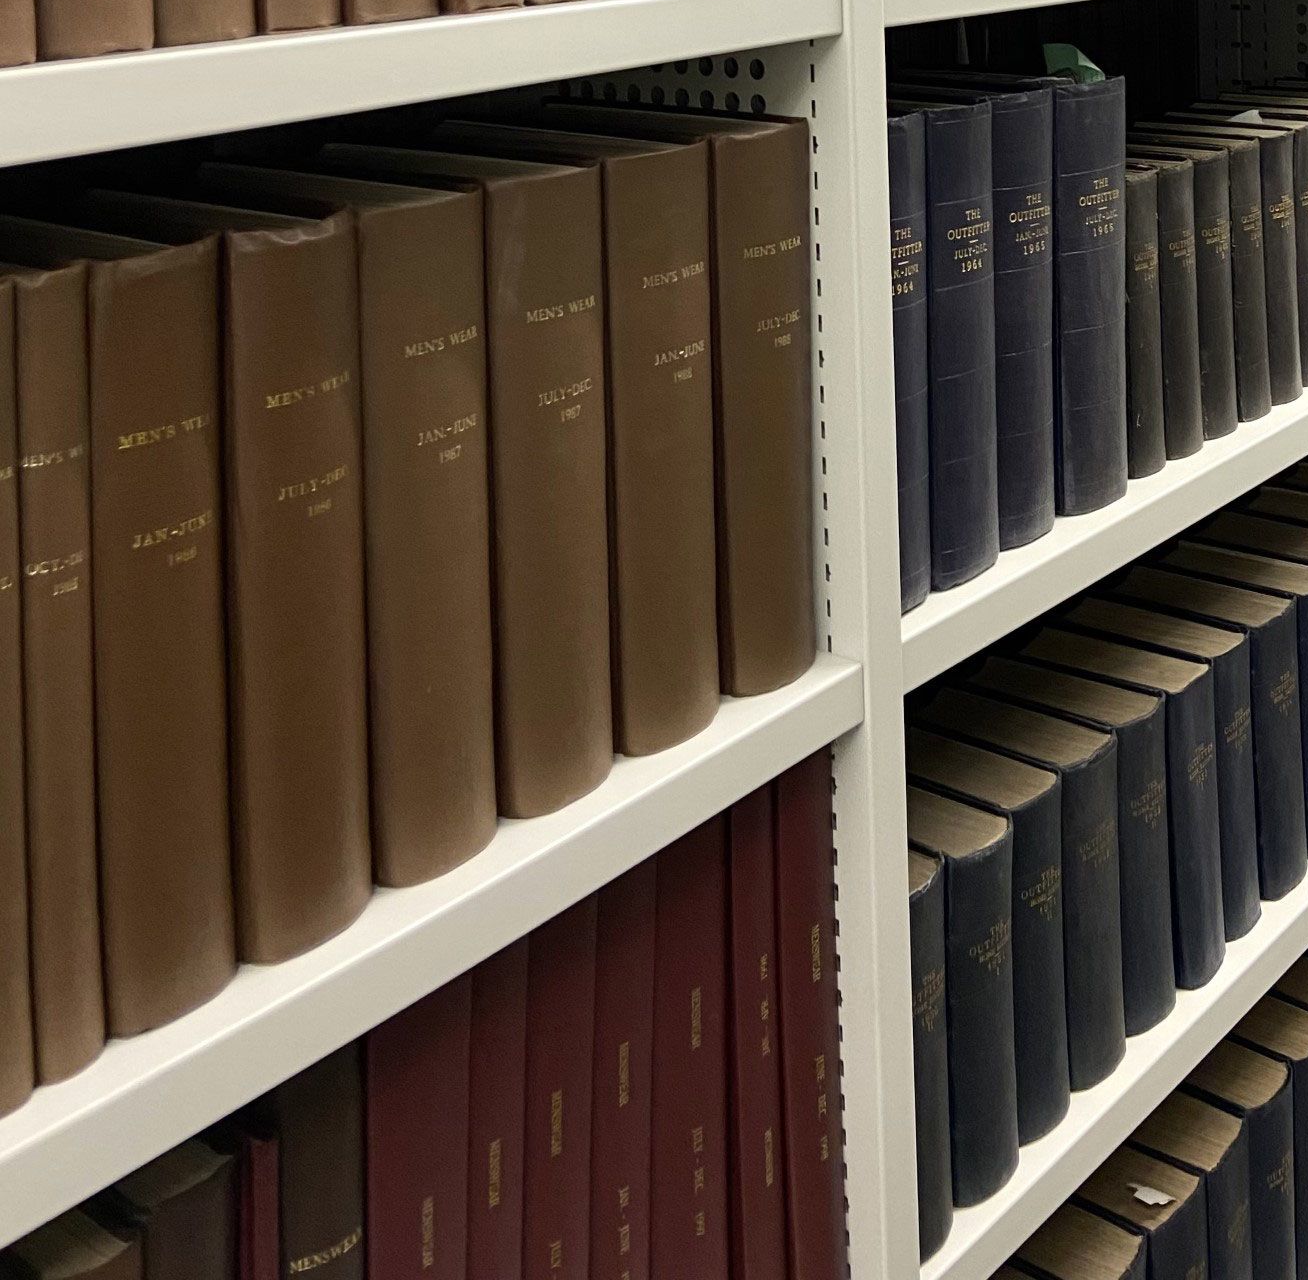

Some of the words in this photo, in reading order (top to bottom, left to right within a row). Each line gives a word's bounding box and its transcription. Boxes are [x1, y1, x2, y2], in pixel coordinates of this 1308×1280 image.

[1093, 177, 1109, 190] THE
[1026, 193, 1042, 206] THE
[1078, 188, 1120, 208] OUTFITTER
[965, 208, 981, 221] THE
[895, 228, 912, 240] THE
[947, 221, 990, 241] OUTFITTER
[1093, 222, 1115, 237] 1965
[743, 243, 776, 259] MEN'S
[779, 236, 802, 251] WEAR
[1023, 241, 1046, 255] 1965
[642, 270, 678, 289] MEN'S
[681, 261, 705, 279] WEAR
[961, 259, 983, 273] 1964
[526, 305, 564, 323] MEN'S
[568, 295, 596, 313] WEAR
[404, 337, 445, 358] MEN'S
[449, 325, 478, 346] WEAR
[266, 386, 315, 409] MEN'S
[560, 404, 581, 422] 1987
[118, 425, 176, 450] MEN'S
[439, 444, 462, 463] 1987
[810, 924, 822, 983] MENSWEAR
[618, 1041, 629, 1108] MENSWEAR
[815, 1054, 826, 1081] JUNE
[818, 1093, 827, 1117] DEC
